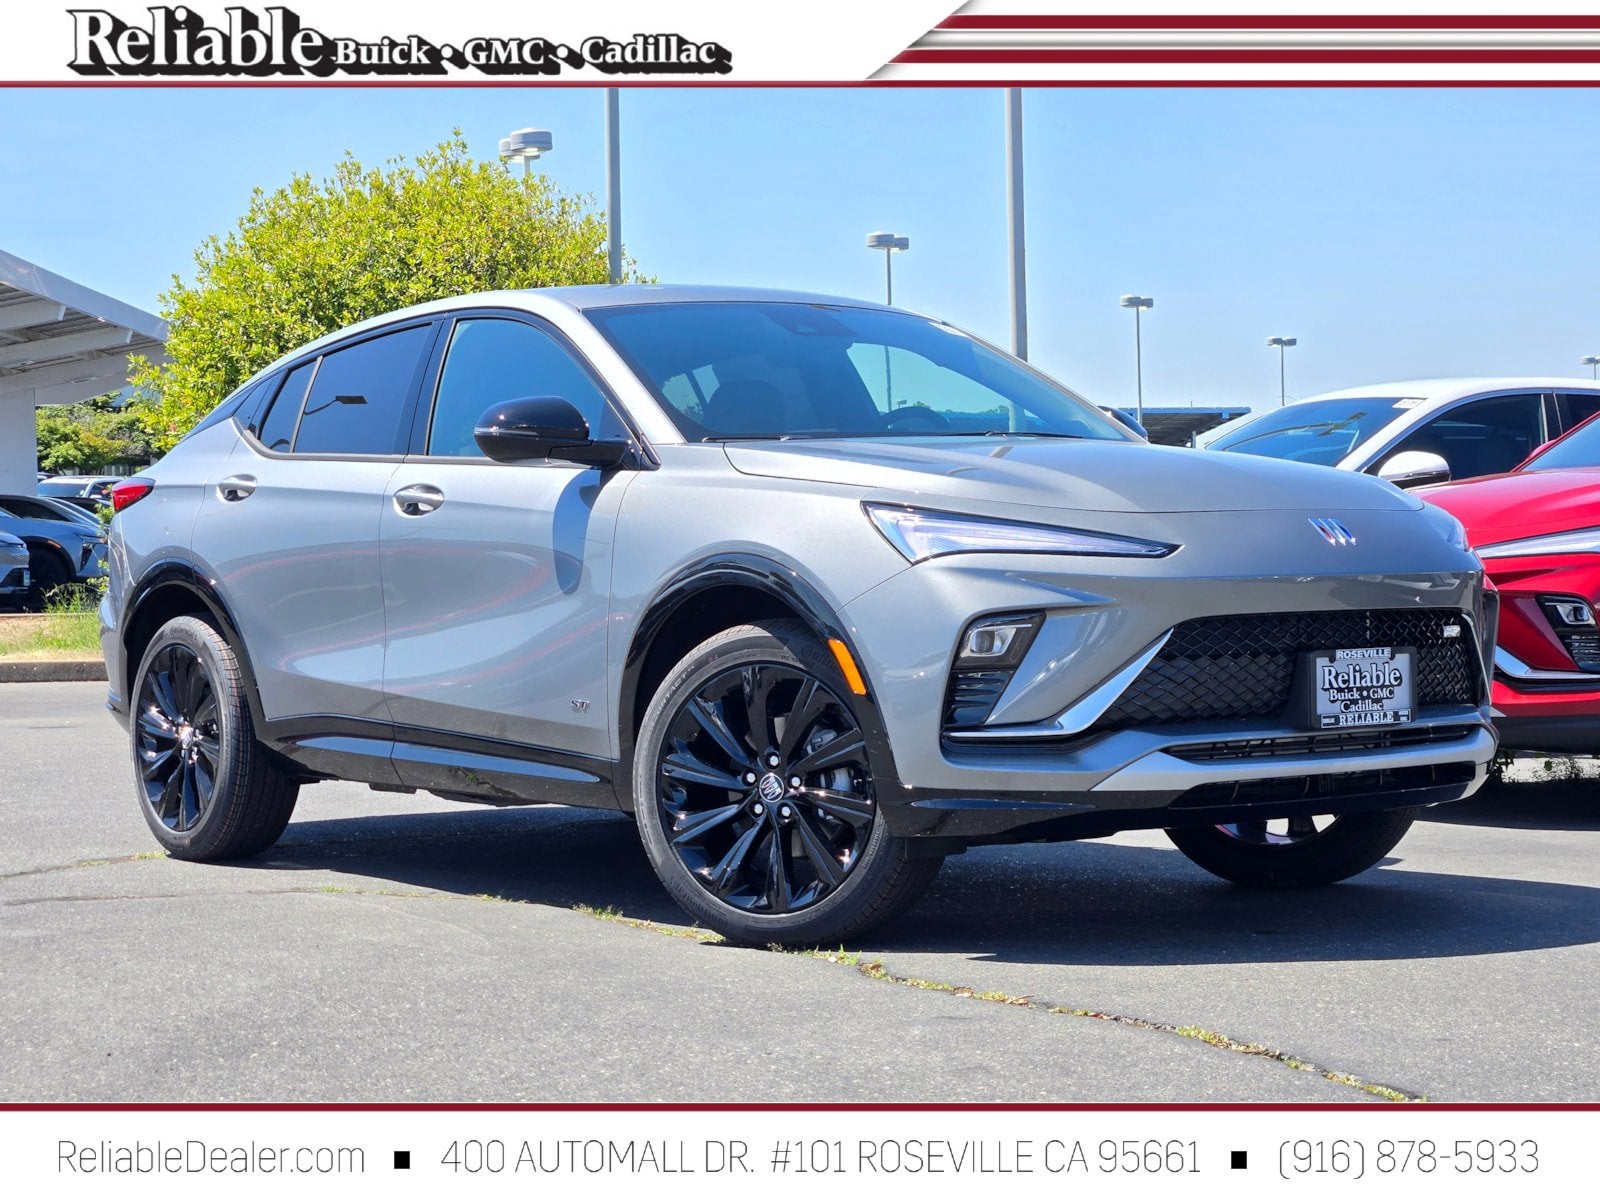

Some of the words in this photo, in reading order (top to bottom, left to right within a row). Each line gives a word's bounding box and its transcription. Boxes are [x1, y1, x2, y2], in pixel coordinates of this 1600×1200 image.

[1336, 648, 1391, 659] ROSEVILLE
[1322, 661, 1402, 689] Reliable
[1329, 689, 1361, 701] Buick
[1369, 687, 1394, 699] GMC
[571, 699, 590, 709] ST
[1341, 700, 1384, 713] Cadillac
[1339, 712, 1394, 726] RELIABLE
